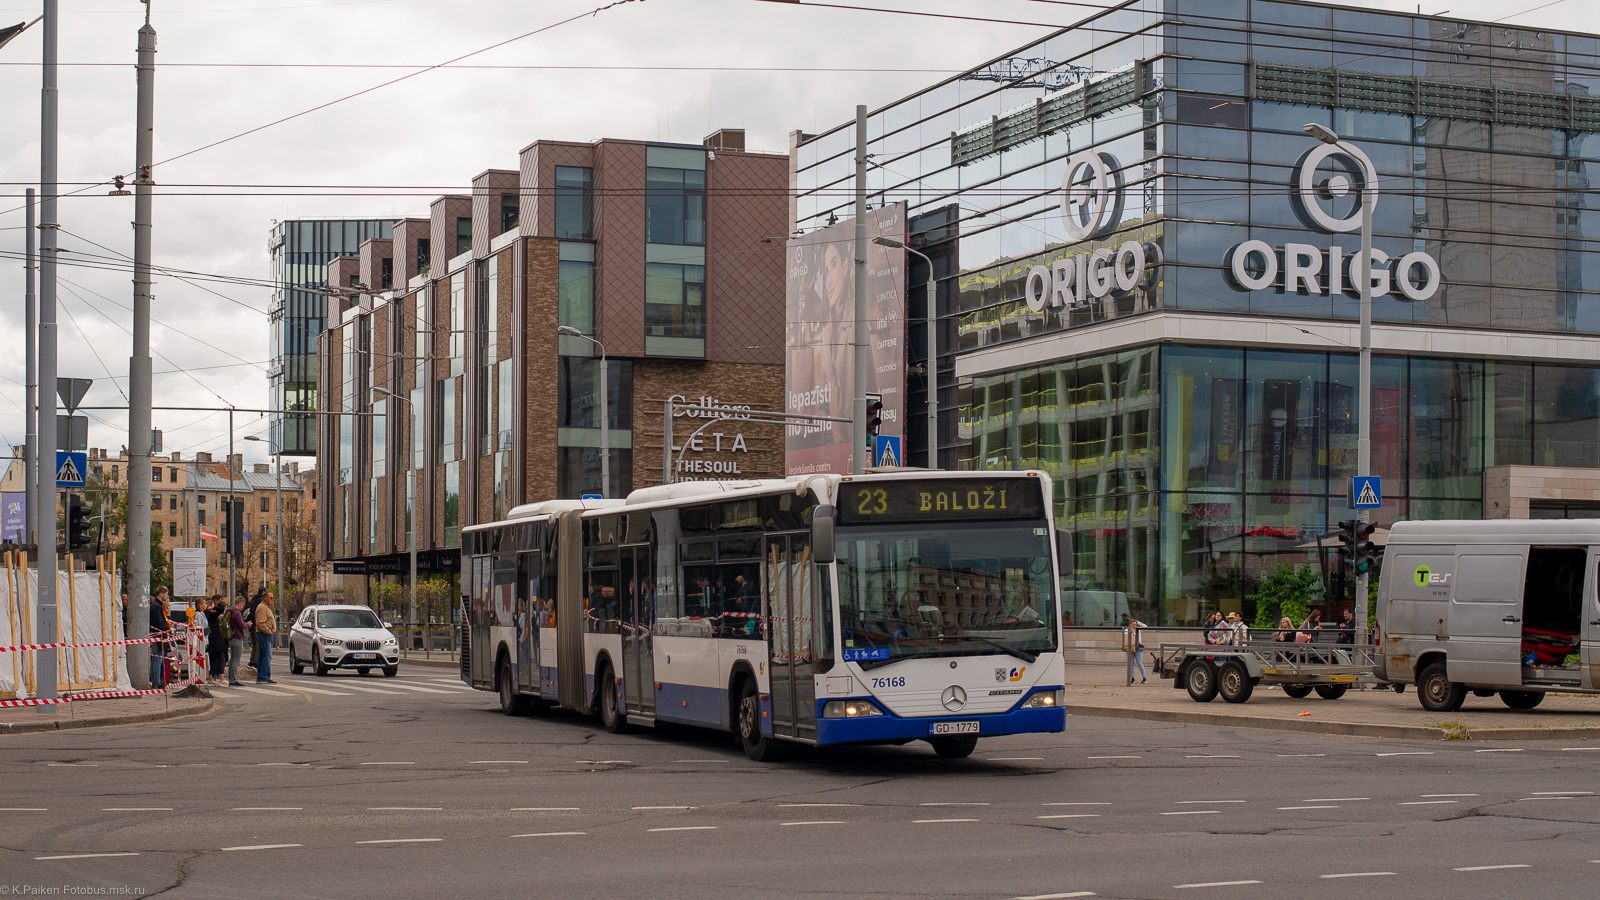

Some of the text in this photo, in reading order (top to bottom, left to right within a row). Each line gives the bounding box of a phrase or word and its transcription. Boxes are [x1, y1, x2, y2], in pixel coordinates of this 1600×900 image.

[790, 264, 808, 279] ORIGO
[877, 266, 898, 277] RESERVED
[1025, 241, 1145, 312] ORIGO
[1232, 240, 1440, 300] ORIGO
[877, 289, 898, 303] LINDEX
[877, 337, 898, 349] CAFFEINE
[789, 382, 832, 411] Iepazīsti
[667, 394, 751, 420] Colliers
[788, 418, 801, 437] no
[671, 432, 748, 452] LETA
[676, 460, 741, 474] THESOUL
[816, 461, 831, 473] centrs
[858, 486, 1006, 514] 23 BALOŽI
[872, 677, 906, 688] 76168
[936, 721, 979, 733] GD-1779
